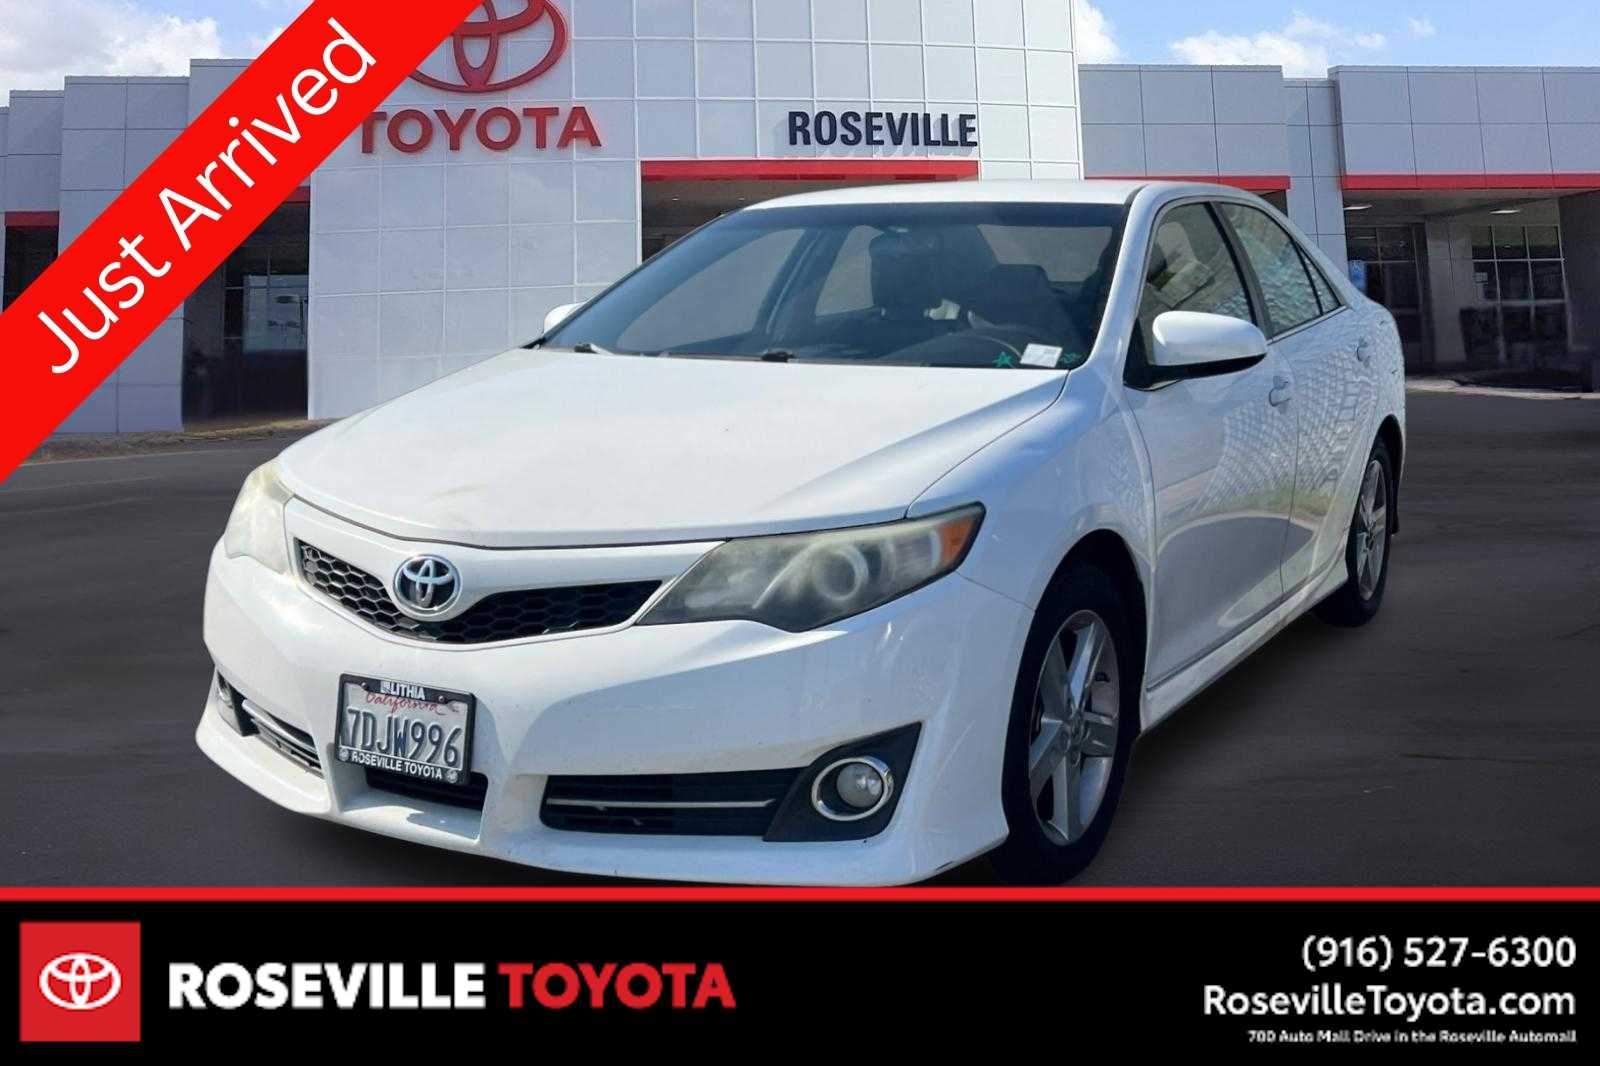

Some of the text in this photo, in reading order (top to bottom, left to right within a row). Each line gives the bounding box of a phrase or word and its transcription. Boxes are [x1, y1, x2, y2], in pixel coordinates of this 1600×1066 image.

[361, 106, 602, 154] TOYOTA
[789, 111, 978, 147] ROSEVILLE
[390, 682, 426, 701] LITHIA
[347, 706, 463, 767] 7DJW996
[351, 750, 443, 780] ROSEVILLE TOYOTA
